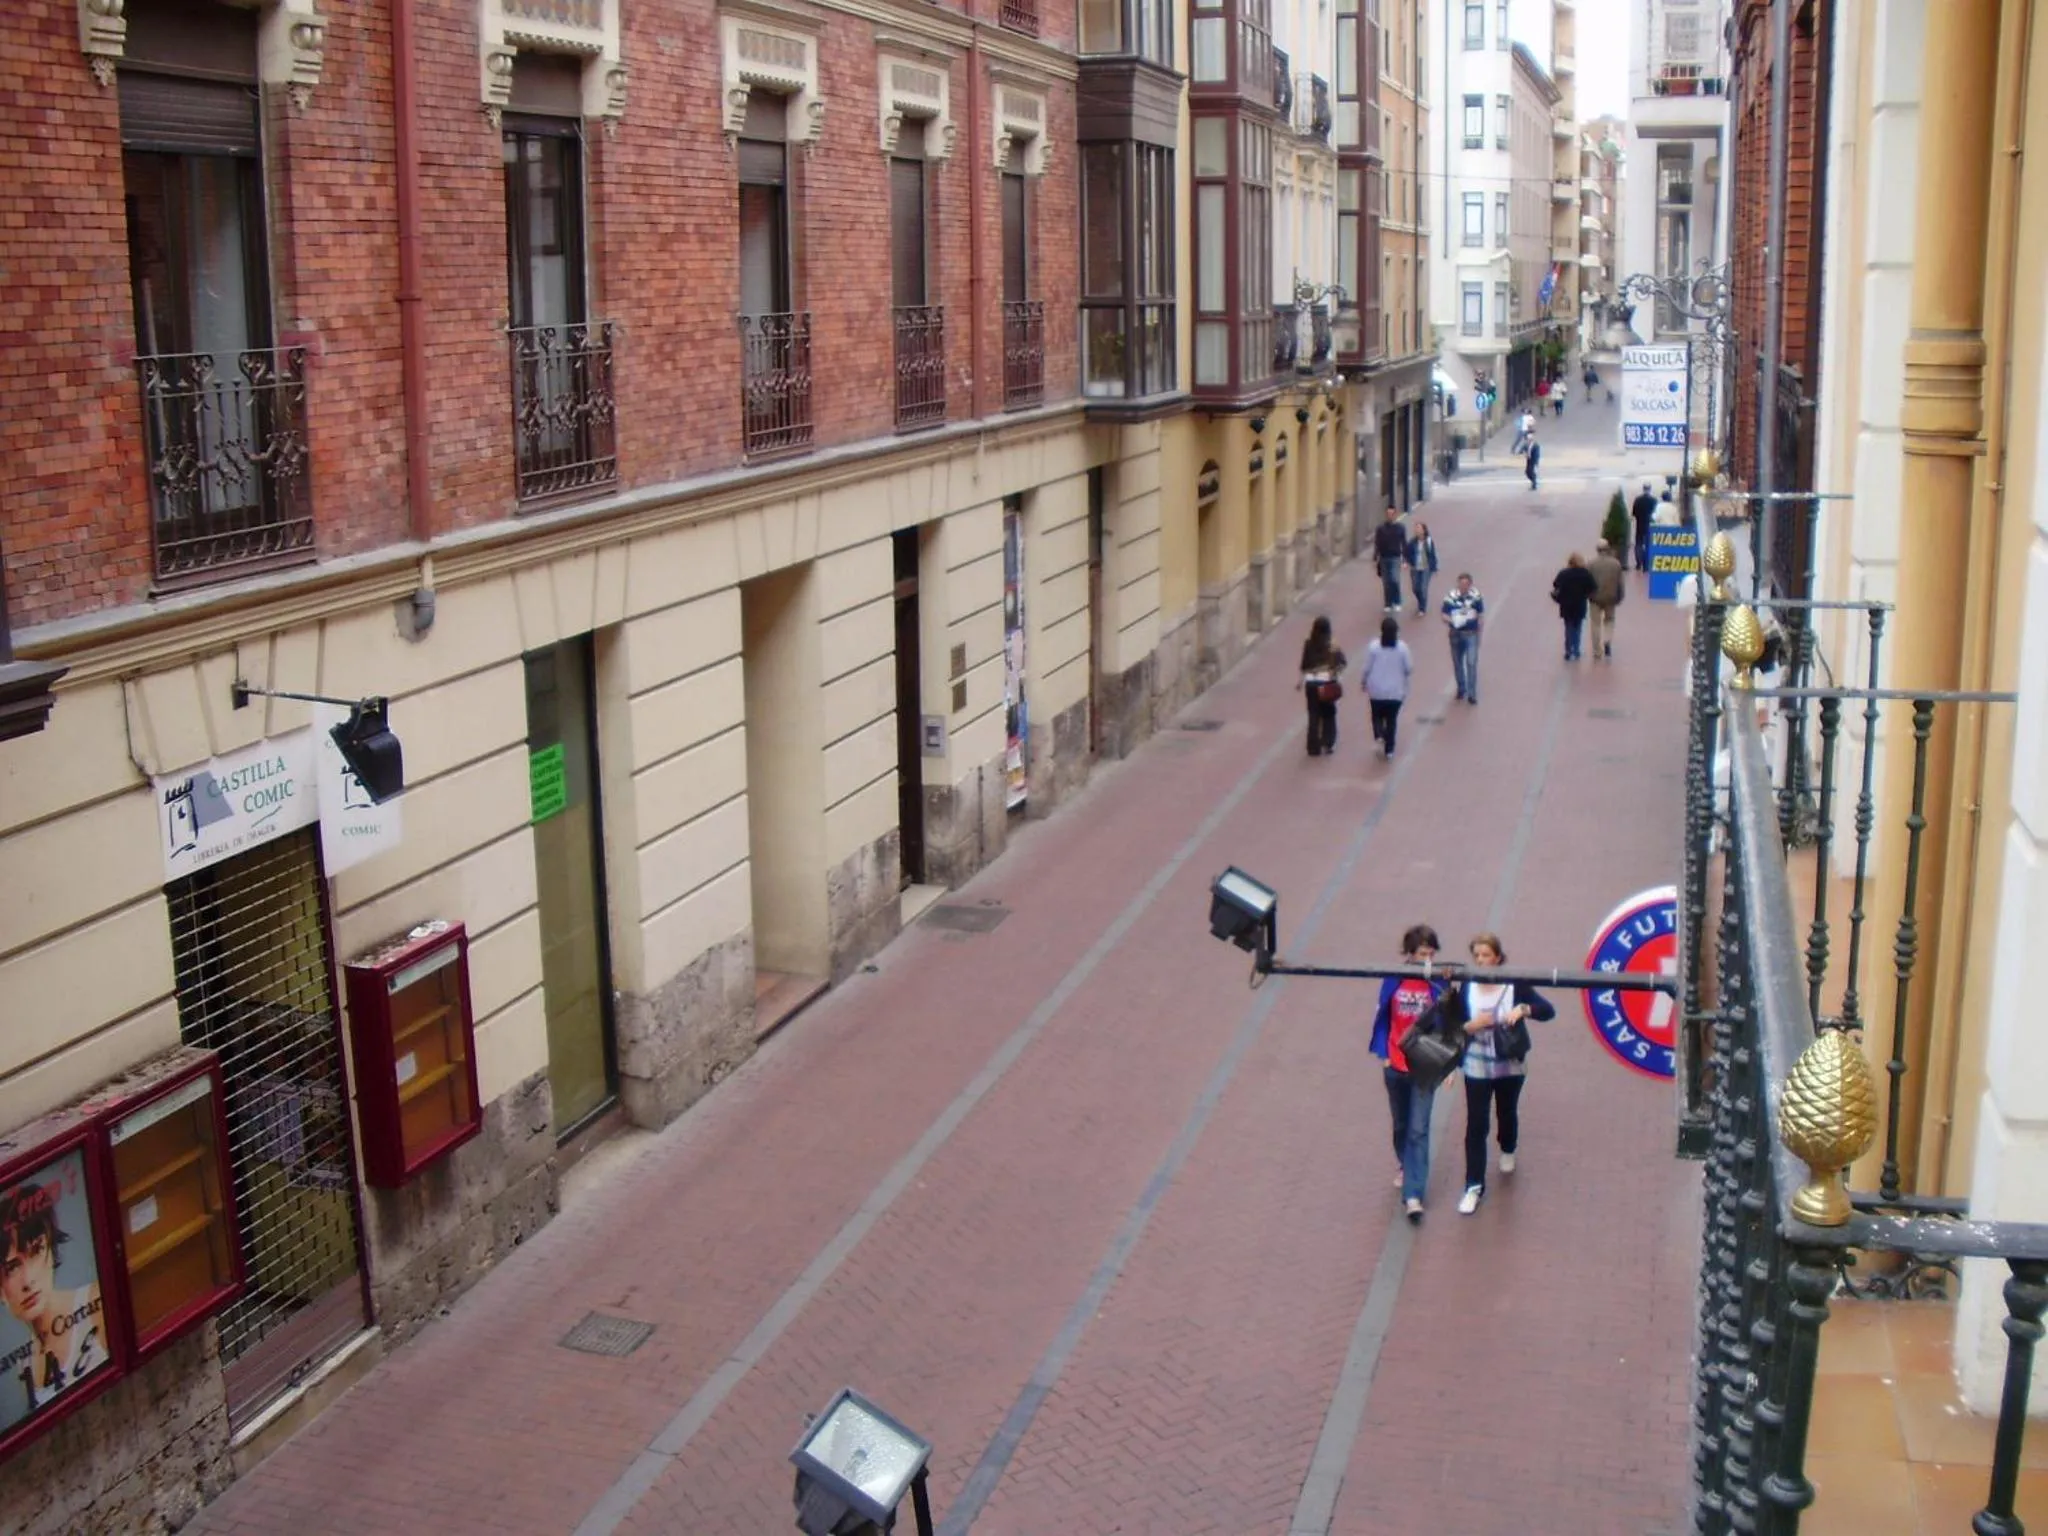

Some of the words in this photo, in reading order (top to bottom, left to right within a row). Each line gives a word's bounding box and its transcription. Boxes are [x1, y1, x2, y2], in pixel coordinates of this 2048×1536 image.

[1624, 351, 1684, 366] ALQUILA
[1631, 399, 1677, 411] SOLCASA
[1626, 426, 1641, 442] 983
[1643, 427, 1655, 442] 36
[1658, 427, 1668, 442] 12
[1672, 427, 1685, 443] 26
[1652, 532, 1697, 547] VIAJES
[207, 755, 286, 799] CASTILLA
[243, 778, 295, 815] COMIC
